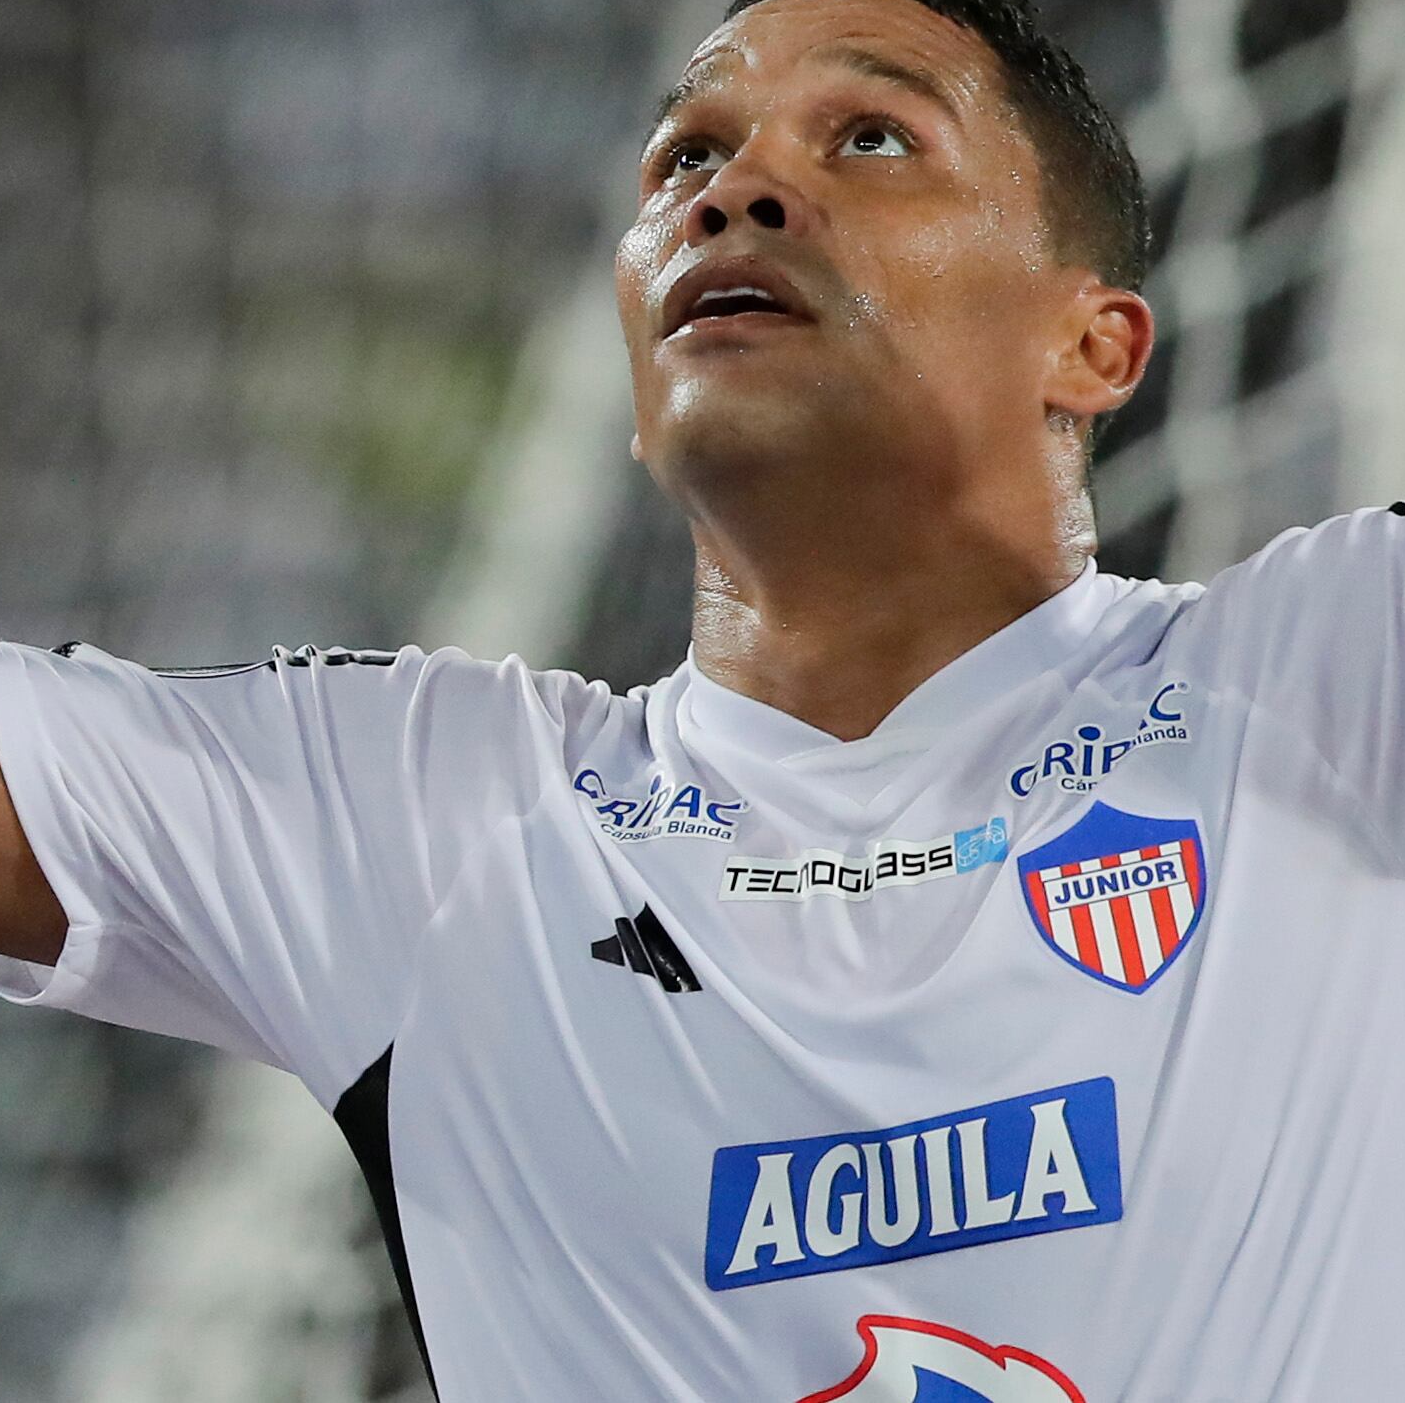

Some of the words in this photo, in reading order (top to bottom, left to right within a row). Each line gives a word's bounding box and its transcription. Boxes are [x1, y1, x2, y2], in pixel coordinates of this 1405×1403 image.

[667, 820, 733, 841] Blanda
[1054, 860, 1178, 905] JUNIOR
[723, 1097, 1097, 1276] AGUILA
